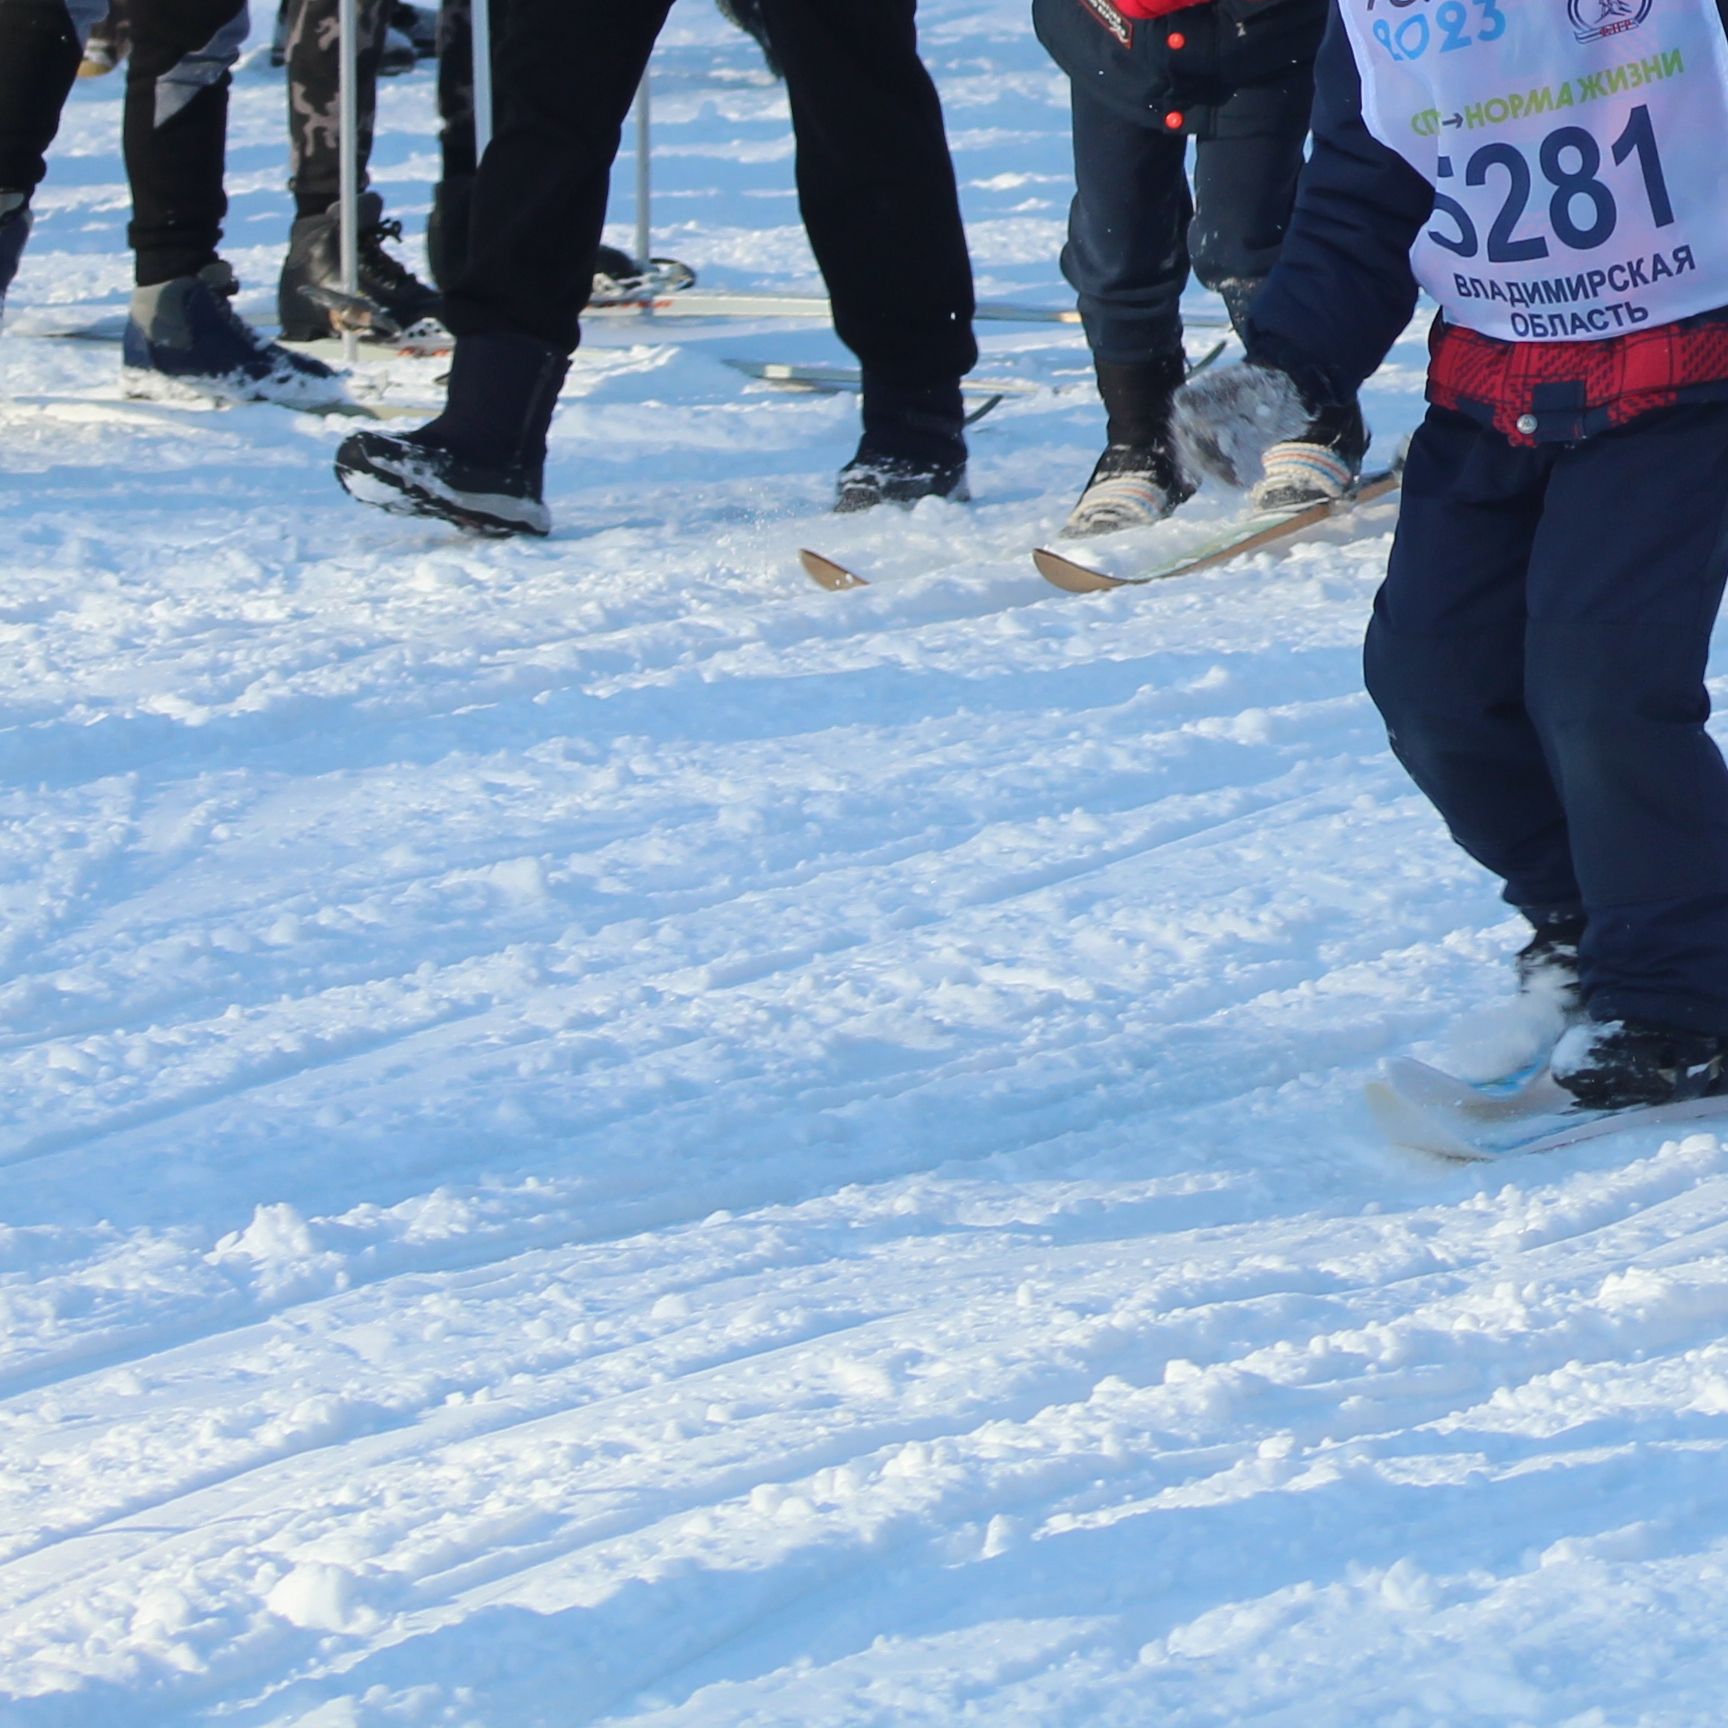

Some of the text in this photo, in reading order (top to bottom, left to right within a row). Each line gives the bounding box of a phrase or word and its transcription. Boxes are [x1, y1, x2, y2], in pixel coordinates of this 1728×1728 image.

[1464, 81, 1574, 130] НОРМА
[1577, 48, 1685, 103] ЖИЗНИ
[1428, 104, 1675, 263] 5281
[1453, 244, 1697, 309] ВЛАДИМИРСКАЯ
[1509, 301, 1650, 338] ОБЛАСТЬ
